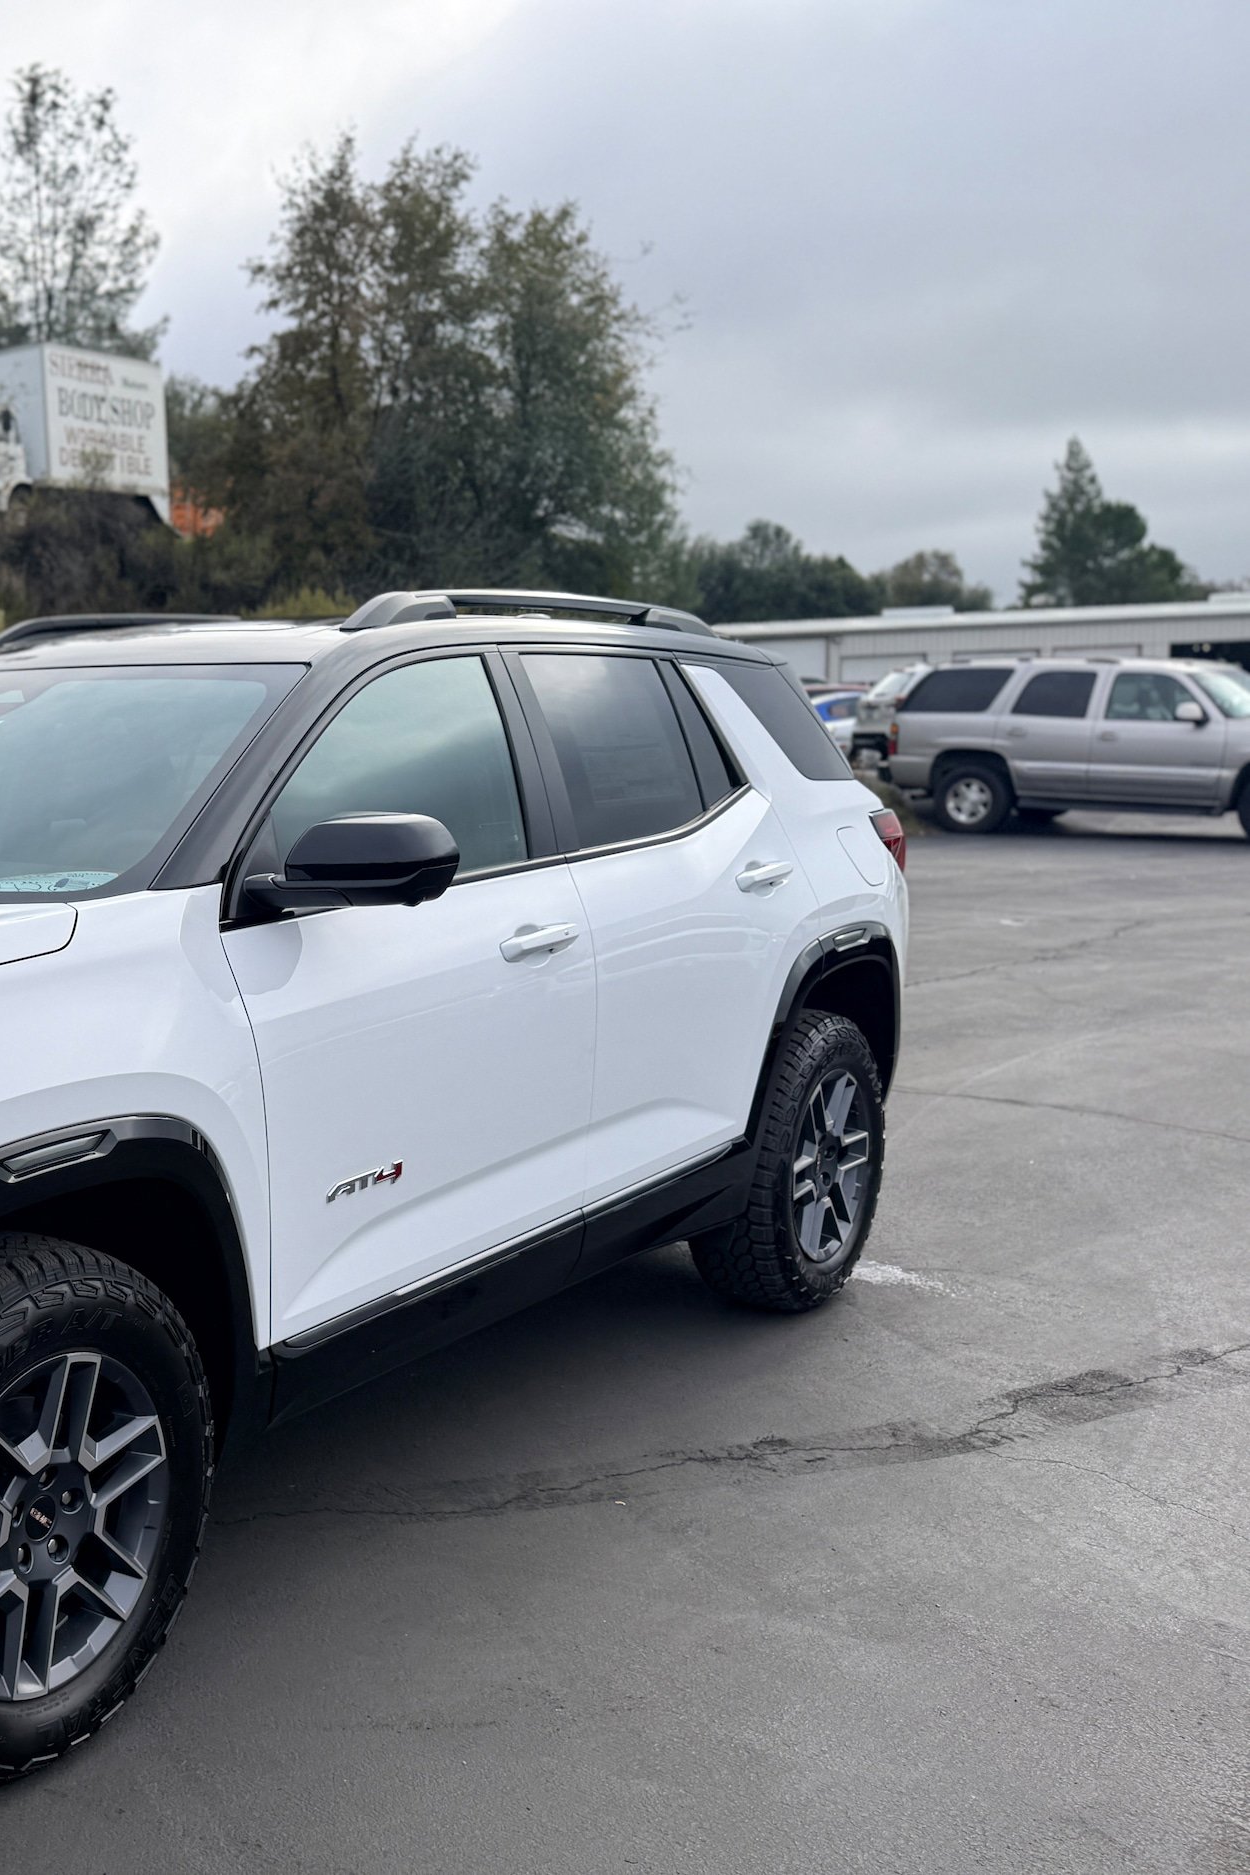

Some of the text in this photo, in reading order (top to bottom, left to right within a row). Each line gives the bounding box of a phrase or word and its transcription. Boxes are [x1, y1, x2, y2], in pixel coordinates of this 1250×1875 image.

[49, 351, 115, 386] SIERRA
[57, 386, 156, 431] BODY SHOP
[326, 1158, 404, 1204] AT4
